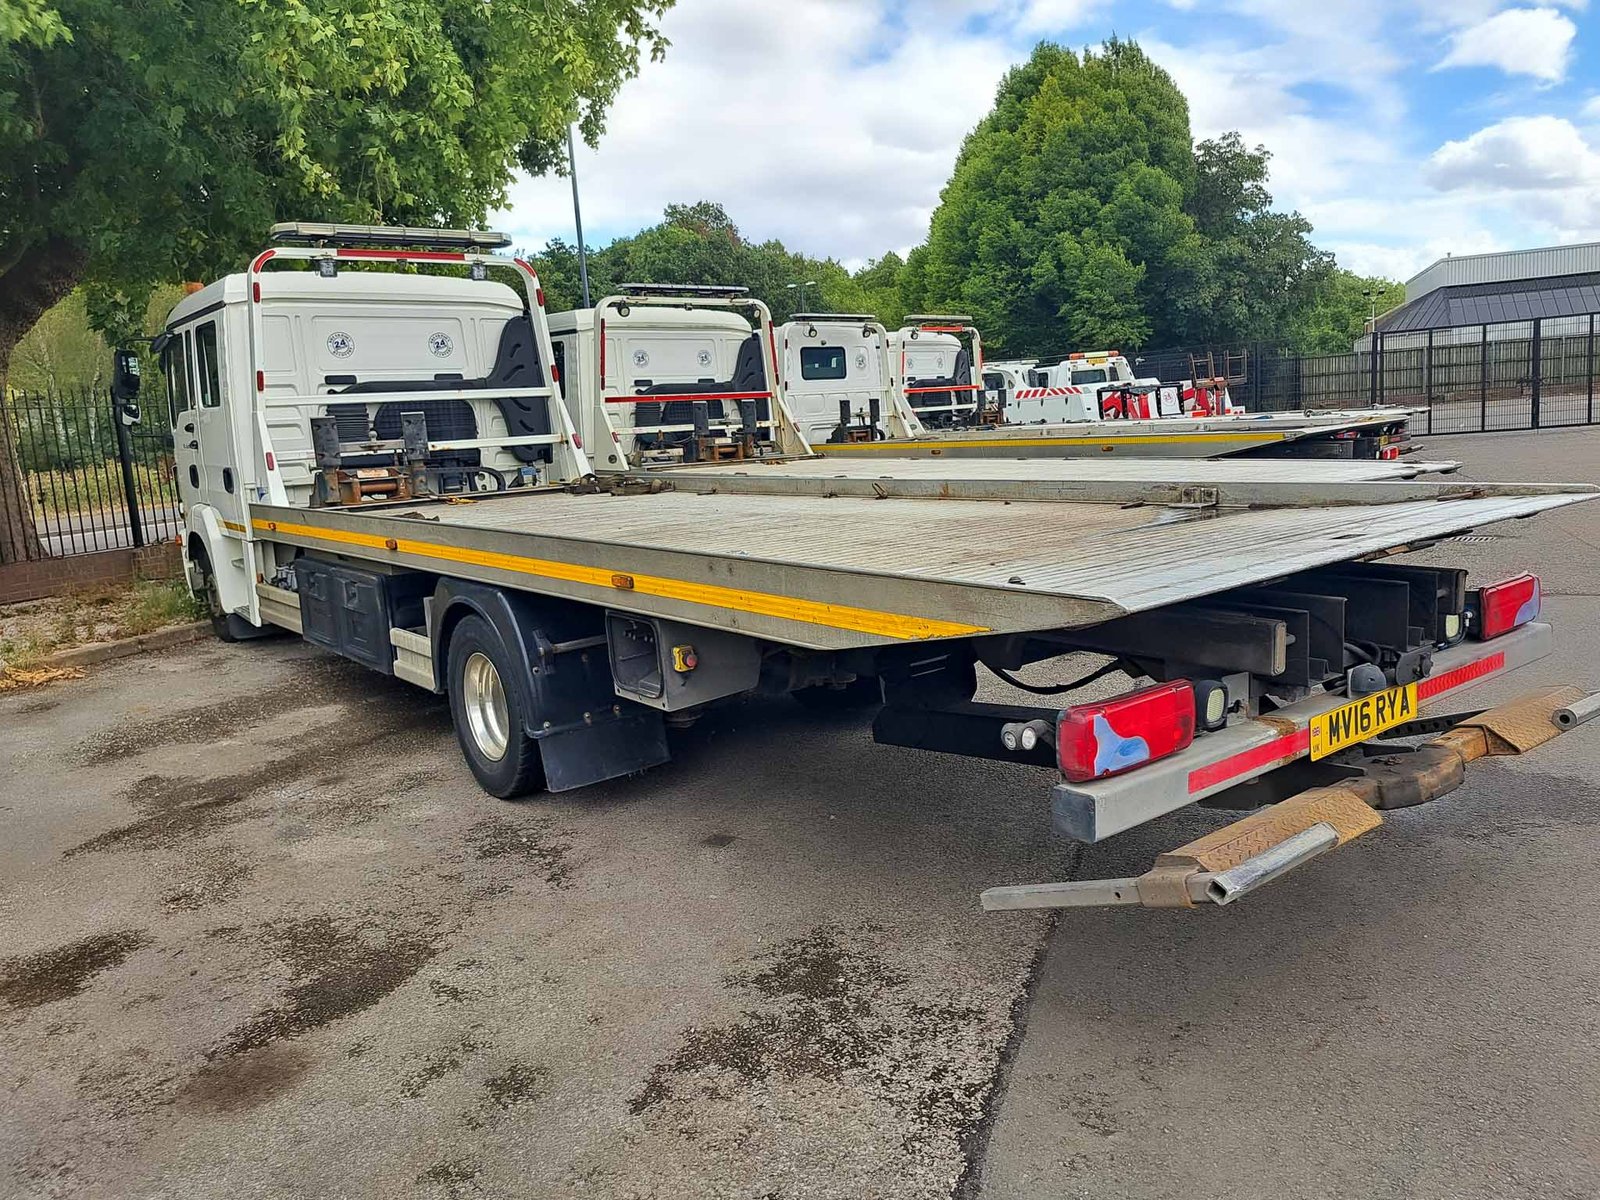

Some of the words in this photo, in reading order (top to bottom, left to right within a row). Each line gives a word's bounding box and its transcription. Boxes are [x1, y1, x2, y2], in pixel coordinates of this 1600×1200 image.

[334, 338, 346, 348] 24
[434, 338, 446, 348] 24
[1329, 701, 1371, 746] MV16
[1376, 686, 1410, 727] RYA
[1312, 743, 1321, 753] UK
